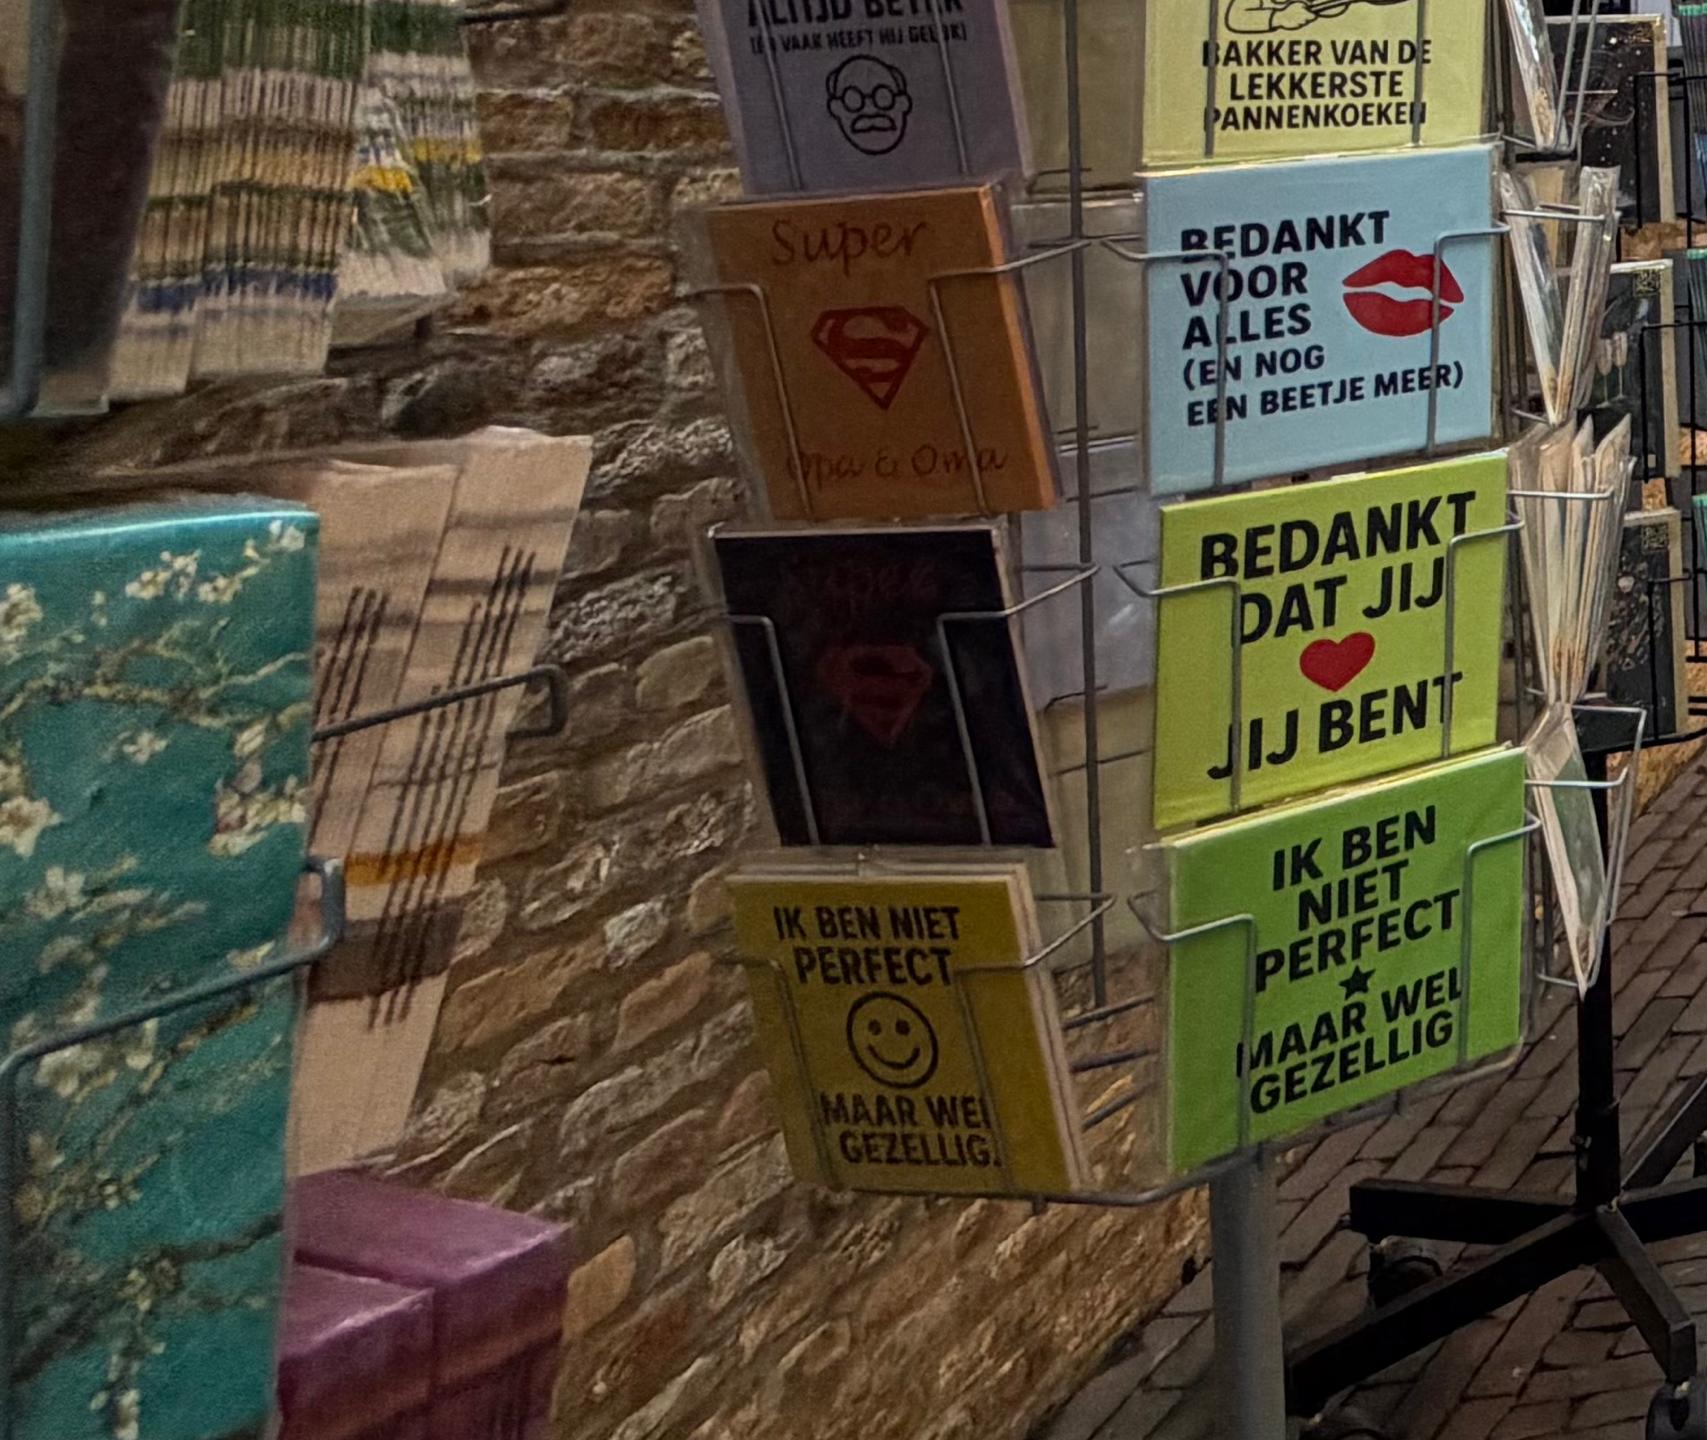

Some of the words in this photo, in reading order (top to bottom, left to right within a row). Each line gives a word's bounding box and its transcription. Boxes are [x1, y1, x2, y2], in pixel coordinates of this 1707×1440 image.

[781, 30, 823, 52] VAAK
[826, 27, 875, 50] HEEFT
[1330, 39, 1389, 65] VAN
[1397, 39, 1432, 65] DE
[1230, 71, 1404, 101] LEKKERSTE
[771, 218, 929, 278] Super
[1180, 210, 1391, 263] BEDANKT
[1180, 261, 1309, 307] VOOR
[1182, 302, 1312, 350] ALLES
[1183, 355, 1242, 391] (EN
[1255, 344, 1325, 378] NOG
[1187, 394, 1248, 427] EEN
[1260, 376, 1365, 416] BEETJE
[1373, 360, 1464, 398] MEER)
[1201, 490, 1477, 580] BEDANKT
[1231, 574, 1348, 648] DAT
[1362, 556, 1446, 620] JIJ
[1207, 708, 1300, 780] JIJ
[1318, 671, 1463, 754] BENT
[1272, 837, 1324, 891] IK
[1342, 805, 1436, 871] BEN
[773, 905, 808, 941] IK
[815, 905, 882, 941] BEN
[888, 905, 961, 941] NIET
[1298, 858, 1410, 932] NIET
[792, 945, 954, 987] PERFECT
[1254, 888, 1461, 994] PERFECT
[1236, 1000, 1367, 1079] MAAR
[1380, 966, 1463, 1024] WEL
[1250, 1009, 1454, 1115] GEZELLIG
[818, 1091, 919, 1127] MAAR
